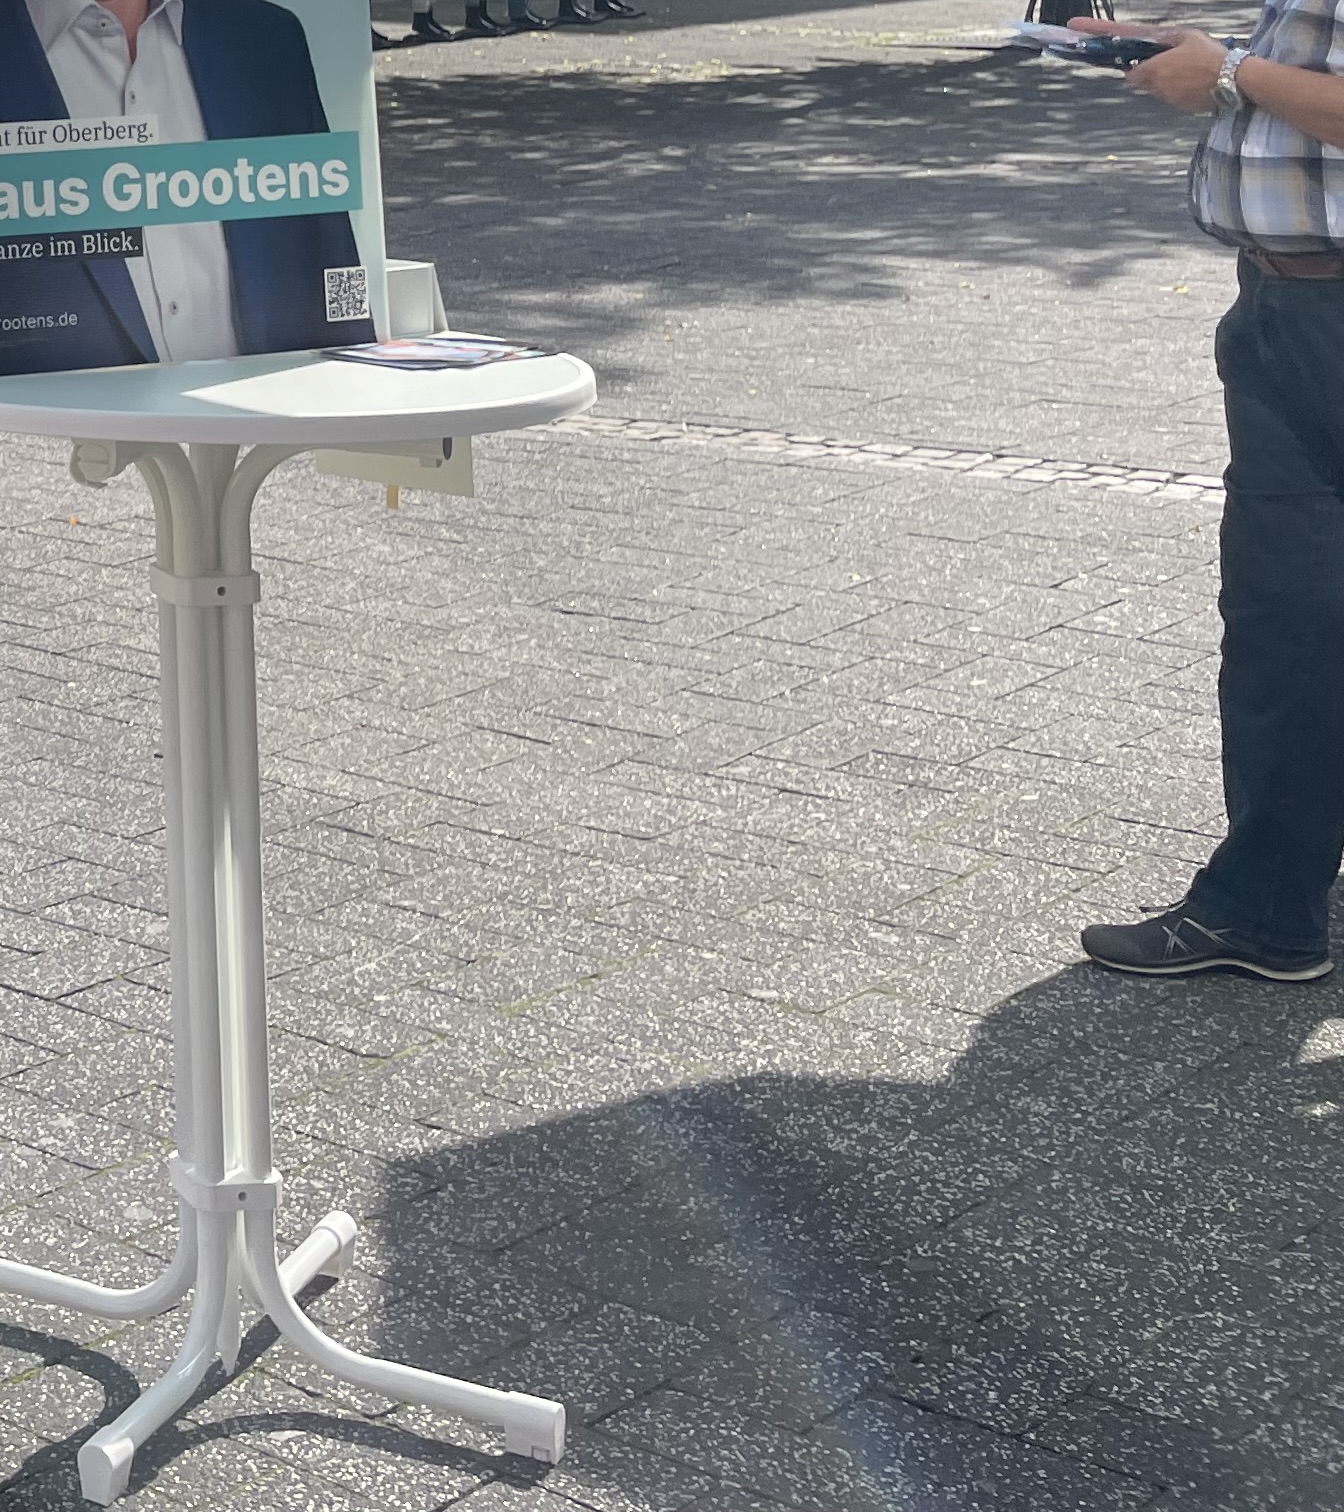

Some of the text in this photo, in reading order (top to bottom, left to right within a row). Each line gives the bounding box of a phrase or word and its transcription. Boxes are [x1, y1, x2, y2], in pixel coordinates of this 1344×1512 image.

[16, 125, 47, 147] für
[52, 121, 154, 146] Oberberg.
[102, 157, 350, 212] Grootens
[49, 236, 76, 257] im
[82, 232, 140, 253] Blick.
